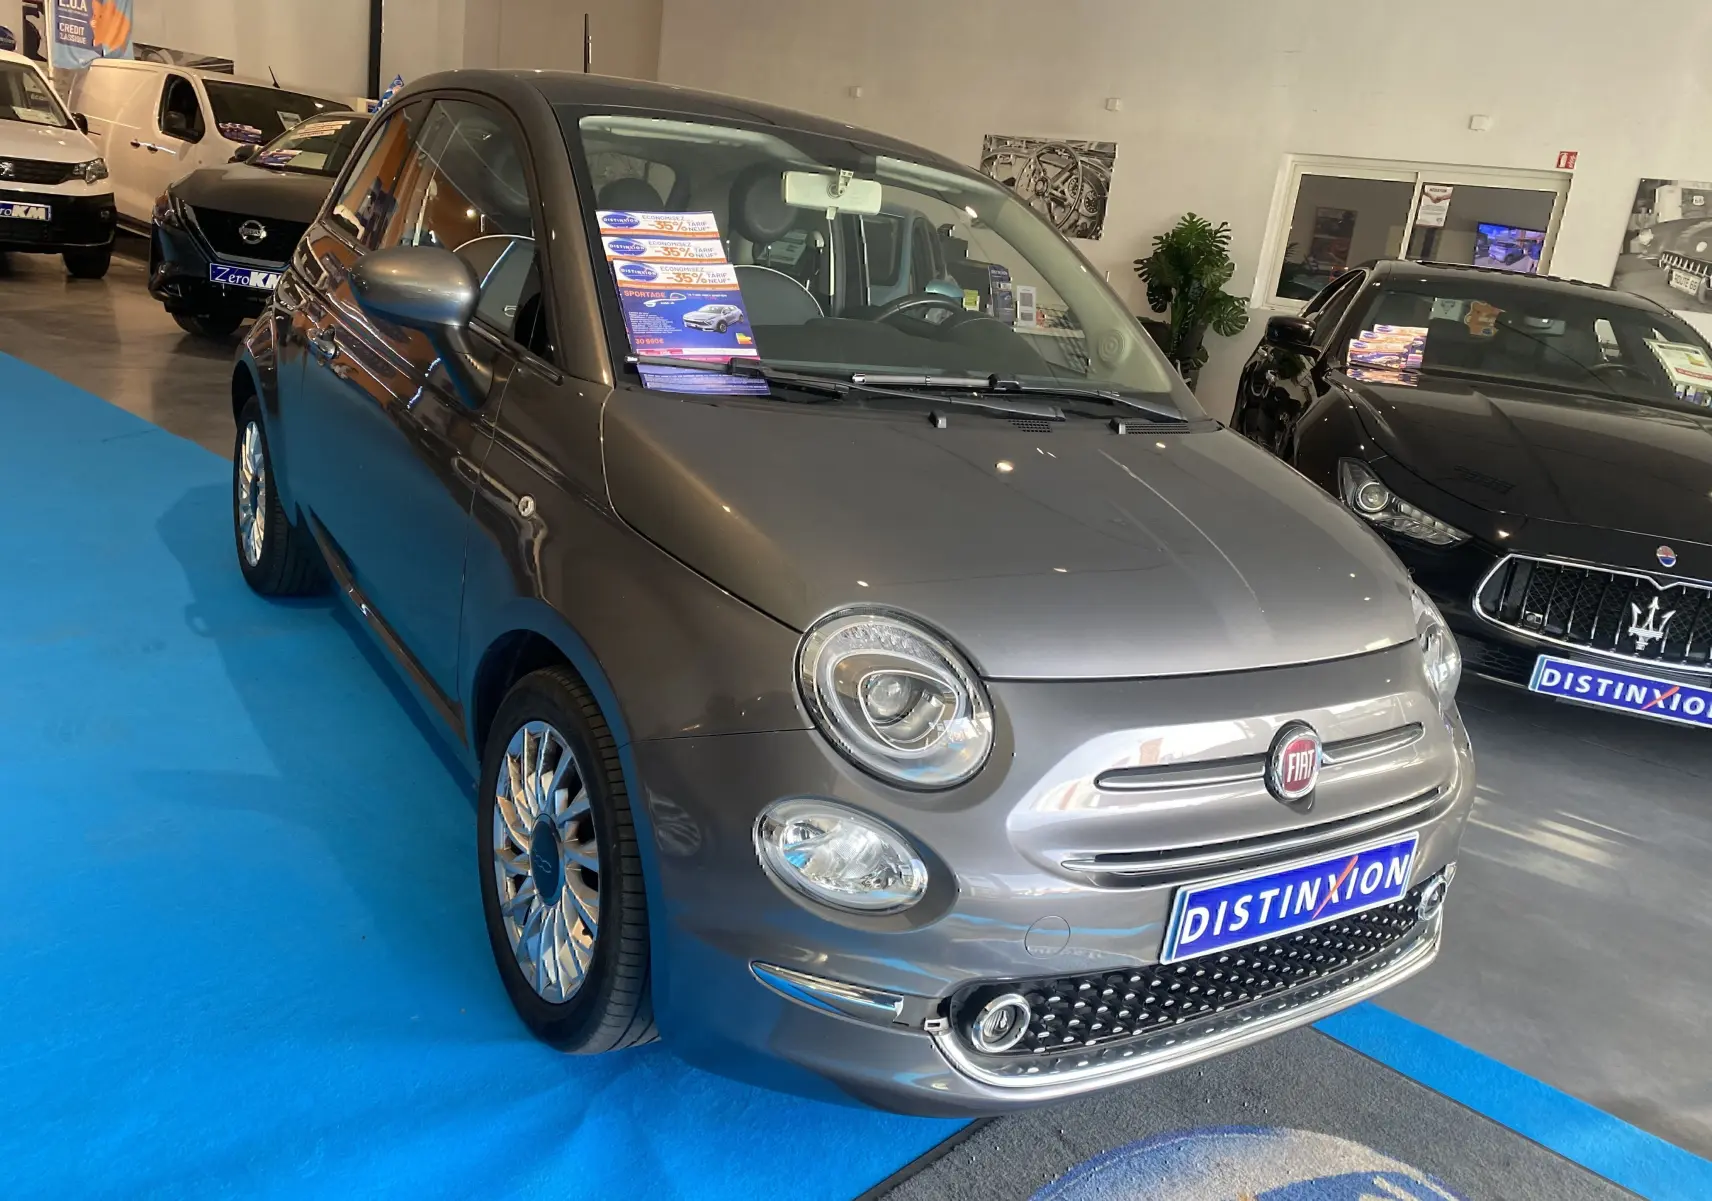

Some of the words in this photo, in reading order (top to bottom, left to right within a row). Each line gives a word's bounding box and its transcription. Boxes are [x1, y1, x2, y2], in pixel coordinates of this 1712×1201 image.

[648, 220, 688, 232] -35%
[654, 246, 695, 258] -35%
[666, 272, 708, 284] -35%
[1287, 749, 1315, 783] FIAT
[1180, 854, 1410, 945] DISTINXION
